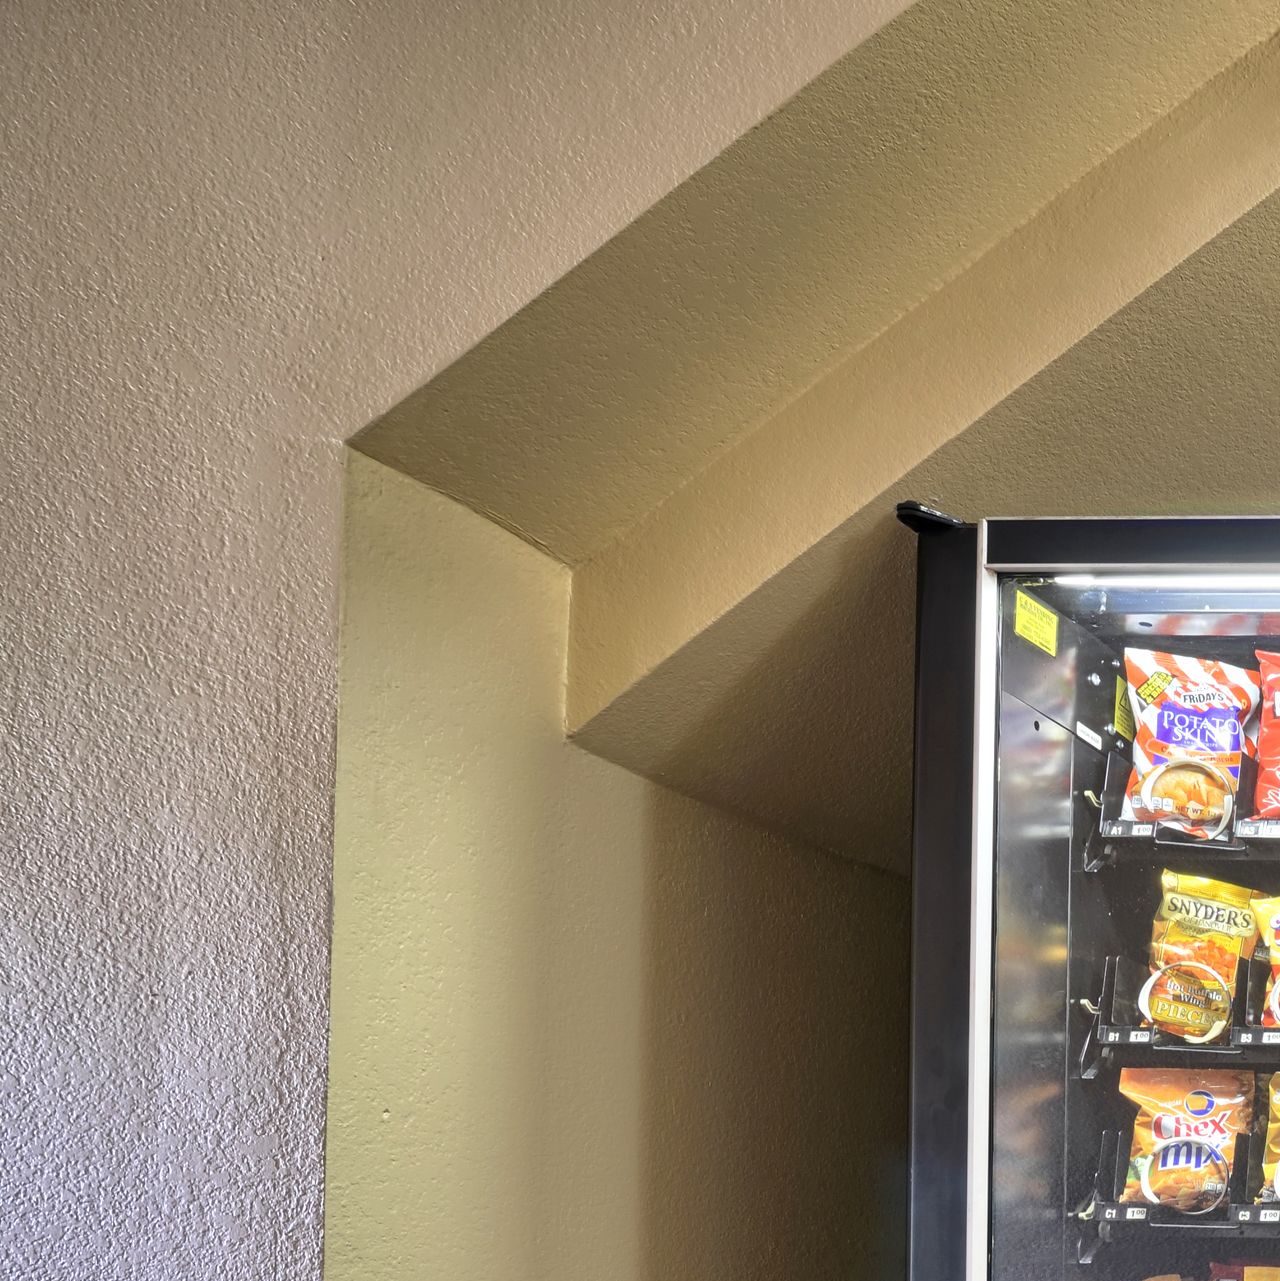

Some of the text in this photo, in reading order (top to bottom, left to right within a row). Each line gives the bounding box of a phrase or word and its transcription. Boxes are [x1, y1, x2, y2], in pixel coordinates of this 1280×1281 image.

[1163, 710, 1239, 735] POTATO
[1172, 726, 1226, 742] SKIN
[1111, 827, 1122, 835] A1
[1167, 896, 1252, 929] SNYDER'S
[1165, 979, 1223, 1002] Hot Buffalo
[1108, 1033, 1120, 1041] B1
[1241, 1034, 1252, 1042] B3
[1153, 1111, 1228, 1140] Chex
[1105, 1210, 1116, 1218] C1
[1239, 1212, 1250, 1220] C3
